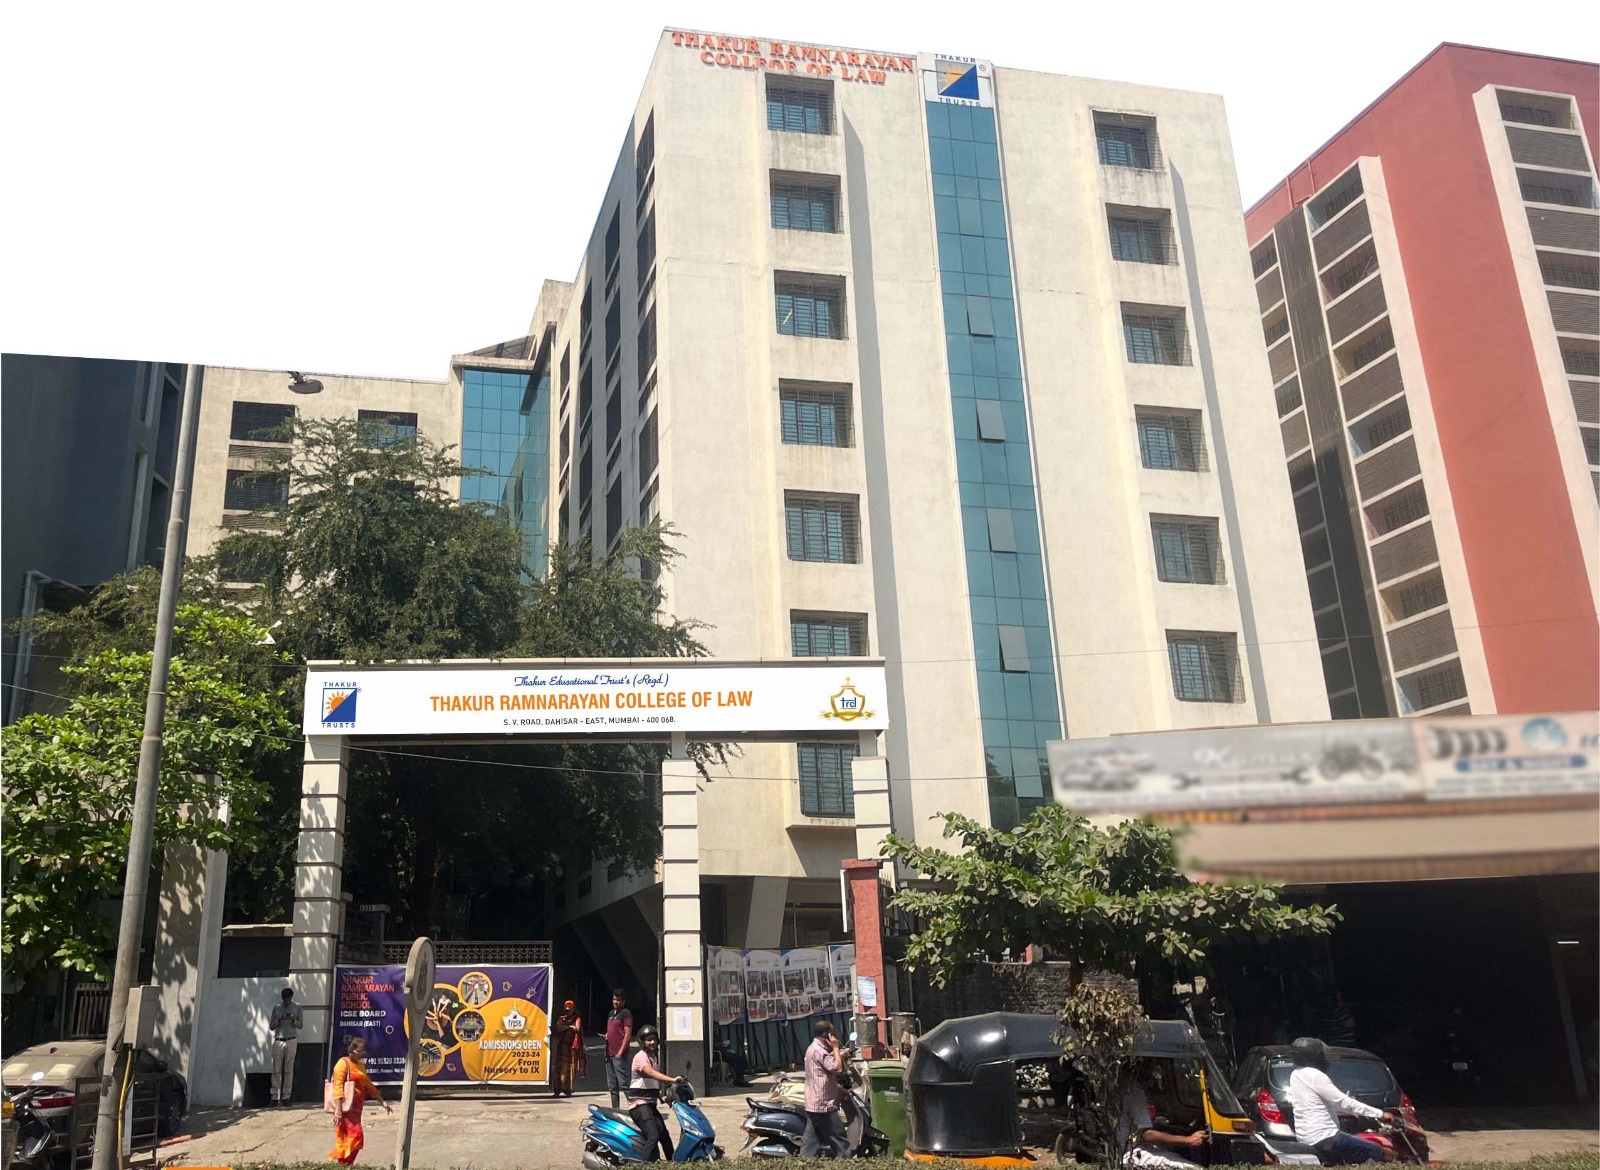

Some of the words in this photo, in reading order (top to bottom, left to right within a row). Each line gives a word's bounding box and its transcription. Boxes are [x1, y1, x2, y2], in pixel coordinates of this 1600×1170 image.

[672, 31, 760, 54] THAKUR
[770, 41, 914, 73] RAMNARAYAN
[935, 53, 976, 64] THAKUR
[841, 66, 886, 85] LAW
[939, 97, 981, 107] TRUSTS
[514, 676, 547, 686] Thakur
[549, 674, 599, 686] Educational
[600, 674, 630, 686] Trust's
[430, 695, 494, 712] THAKUR
[500, 693, 610, 711] RAMNARAYAN
[615, 692, 686, 709] COLLEGE
[692, 691, 712, 708] OF
[717, 691, 753, 707] LAW
[840, 697, 857, 708] trcl
[585, 717, 607, 726] EAST,
[646, 716, 660, 724] 400
[341, 993, 368, 1001] PUBLIC
[340, 1001, 371, 1009] SCHOOL
[363, 1020, 381, 1028] (EAST)
[479, 1040, 522, 1050] ADMISSIONS
[523, 1039, 542, 1050] OPEN
[520, 1066, 529, 1074] to
[531, 1066, 540, 1074] IX
